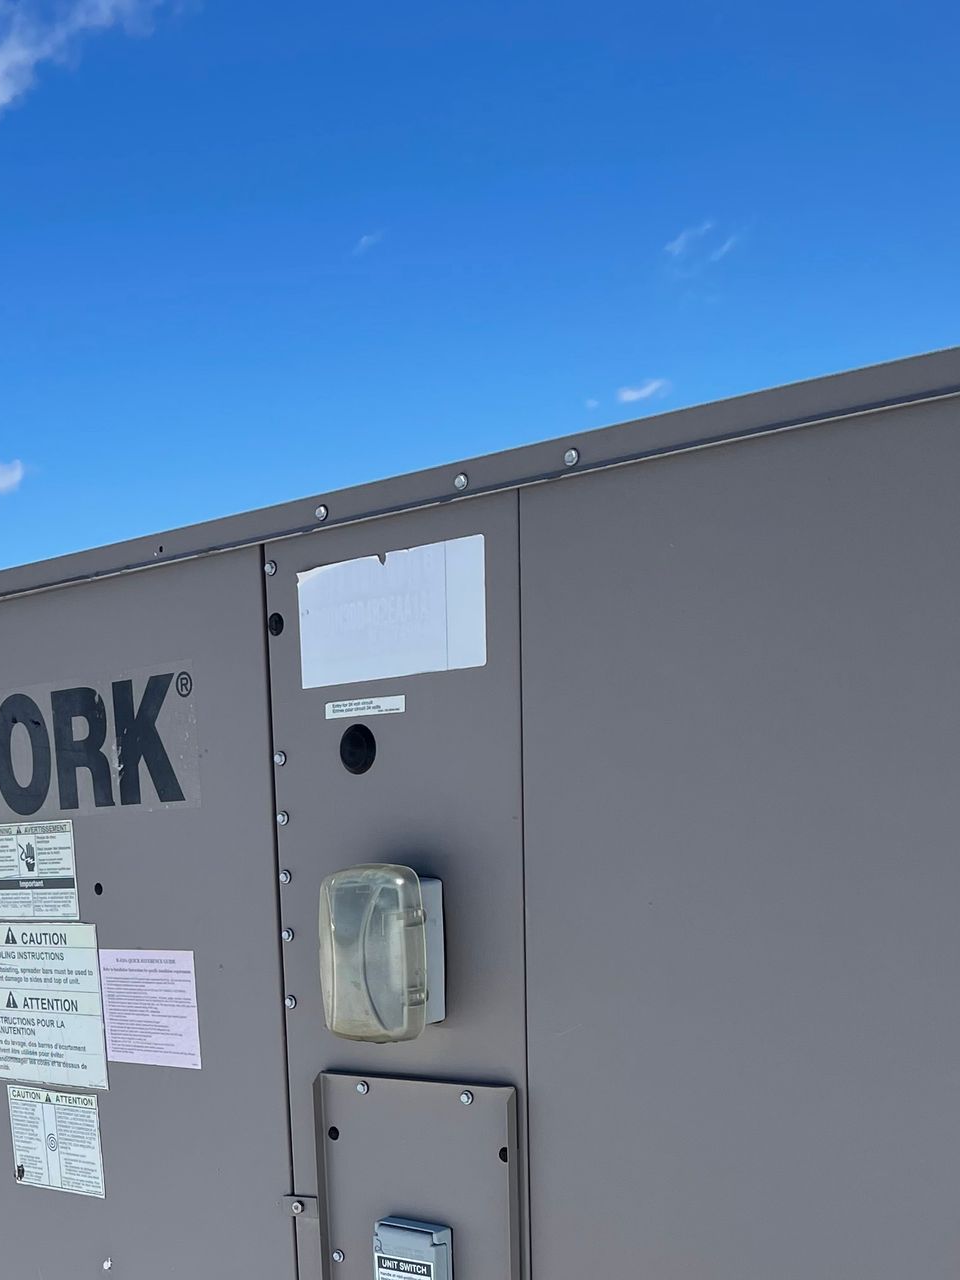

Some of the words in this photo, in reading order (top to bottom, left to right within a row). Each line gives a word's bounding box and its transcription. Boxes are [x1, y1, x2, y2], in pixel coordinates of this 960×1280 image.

[24, 825, 67, 834] AVERTISSEMENT
[19, 880, 44, 889] Important
[21, 933, 67, 945] CAUTION
[17, 952, 64, 961] INSTRUCTIONS
[23, 996, 78, 1012] ATTENTION
[37, 1019, 55, 1028] POUR
[56, 1021, 65, 1029] LA
[12, 1090, 41, 1100] CAUTION
[55, 1096, 93, 1106] ATTENTION
[382, 1259, 398, 1269] UNIT
[400, 1262, 427, 1274] SWITCH
